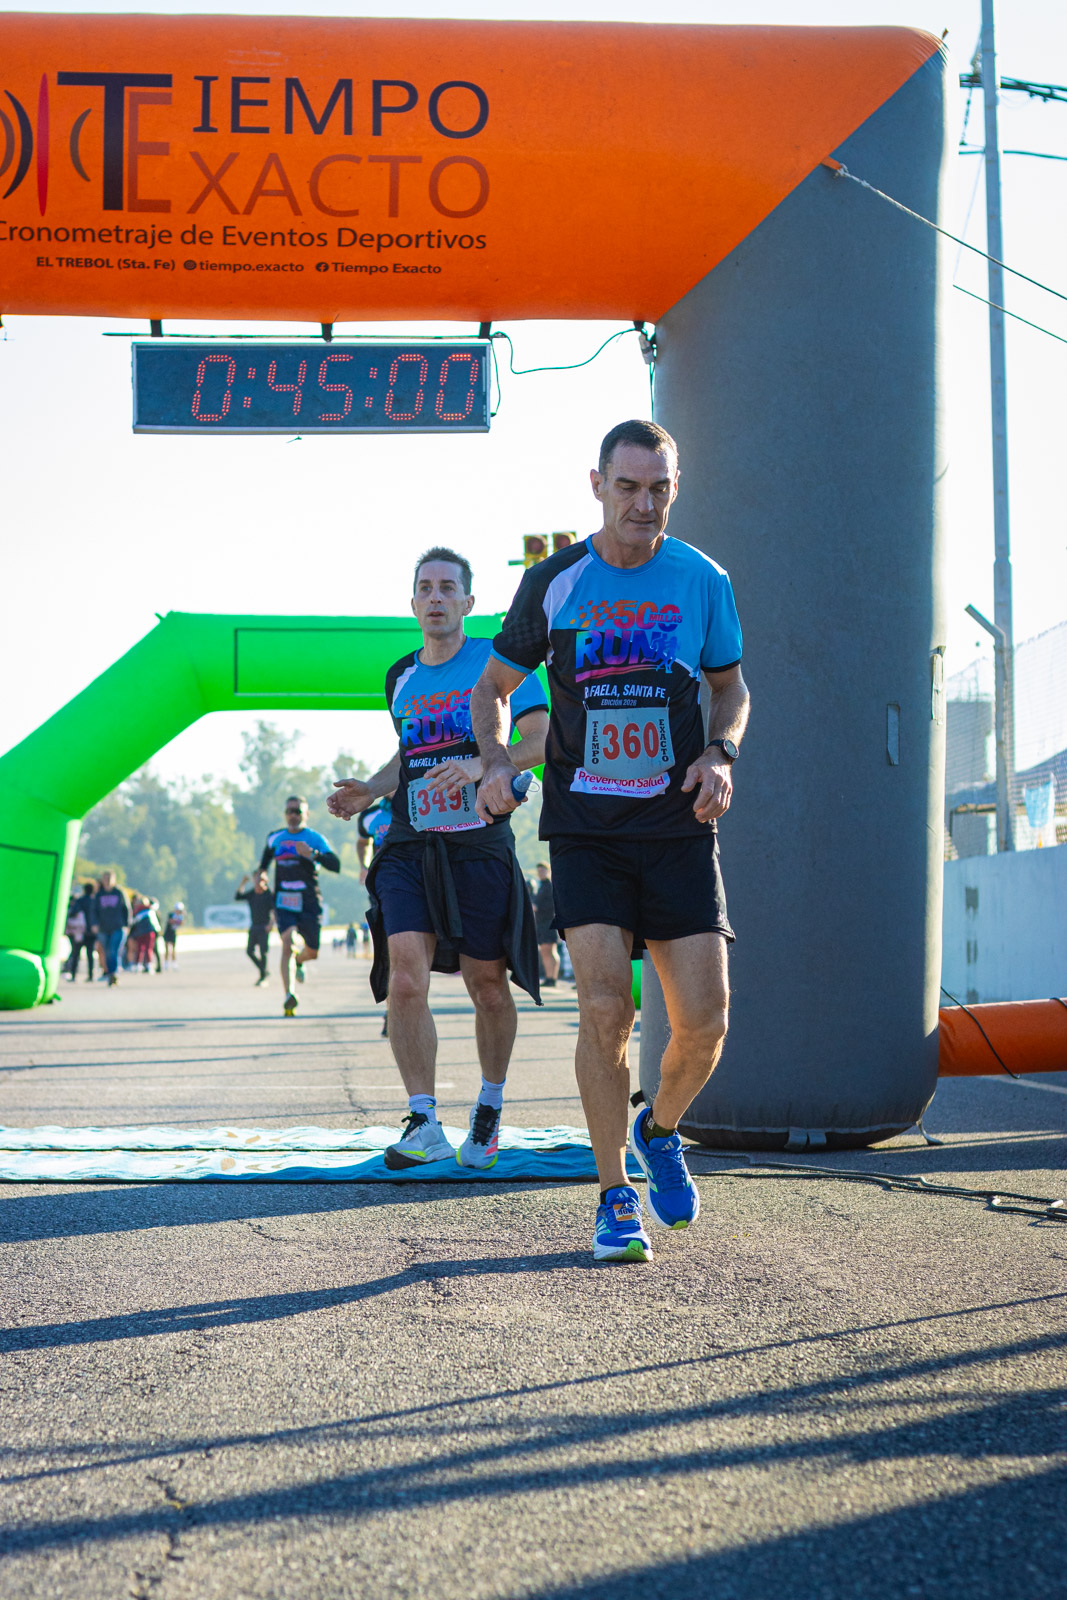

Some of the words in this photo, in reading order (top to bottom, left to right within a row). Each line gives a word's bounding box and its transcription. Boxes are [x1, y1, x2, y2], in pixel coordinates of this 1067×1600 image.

[180, 224, 214, 245] de
[222, 225, 328, 247] Eventos
[337, 227, 487, 253] Deportivos
[36, 256, 54, 267] EL
[56, 257, 114, 269] TREBOL
[117, 257, 151, 271] (Sta.
[154, 258, 176, 271] Fe)
[199, 260, 304, 273] tiempo.exacto
[331, 261, 389, 275] Tiempo
[393, 263, 442, 274] Exacto
[191, 353, 479, 421] 0:45:00
[649, 613, 683, 624] MILLAS
[622, 684, 653, 698] SANTA
[654, 686, 666, 699] FE
[602, 721, 660, 760] 360
[658, 719, 669, 762] EXACTO
[636, 775, 665, 788] Salud
